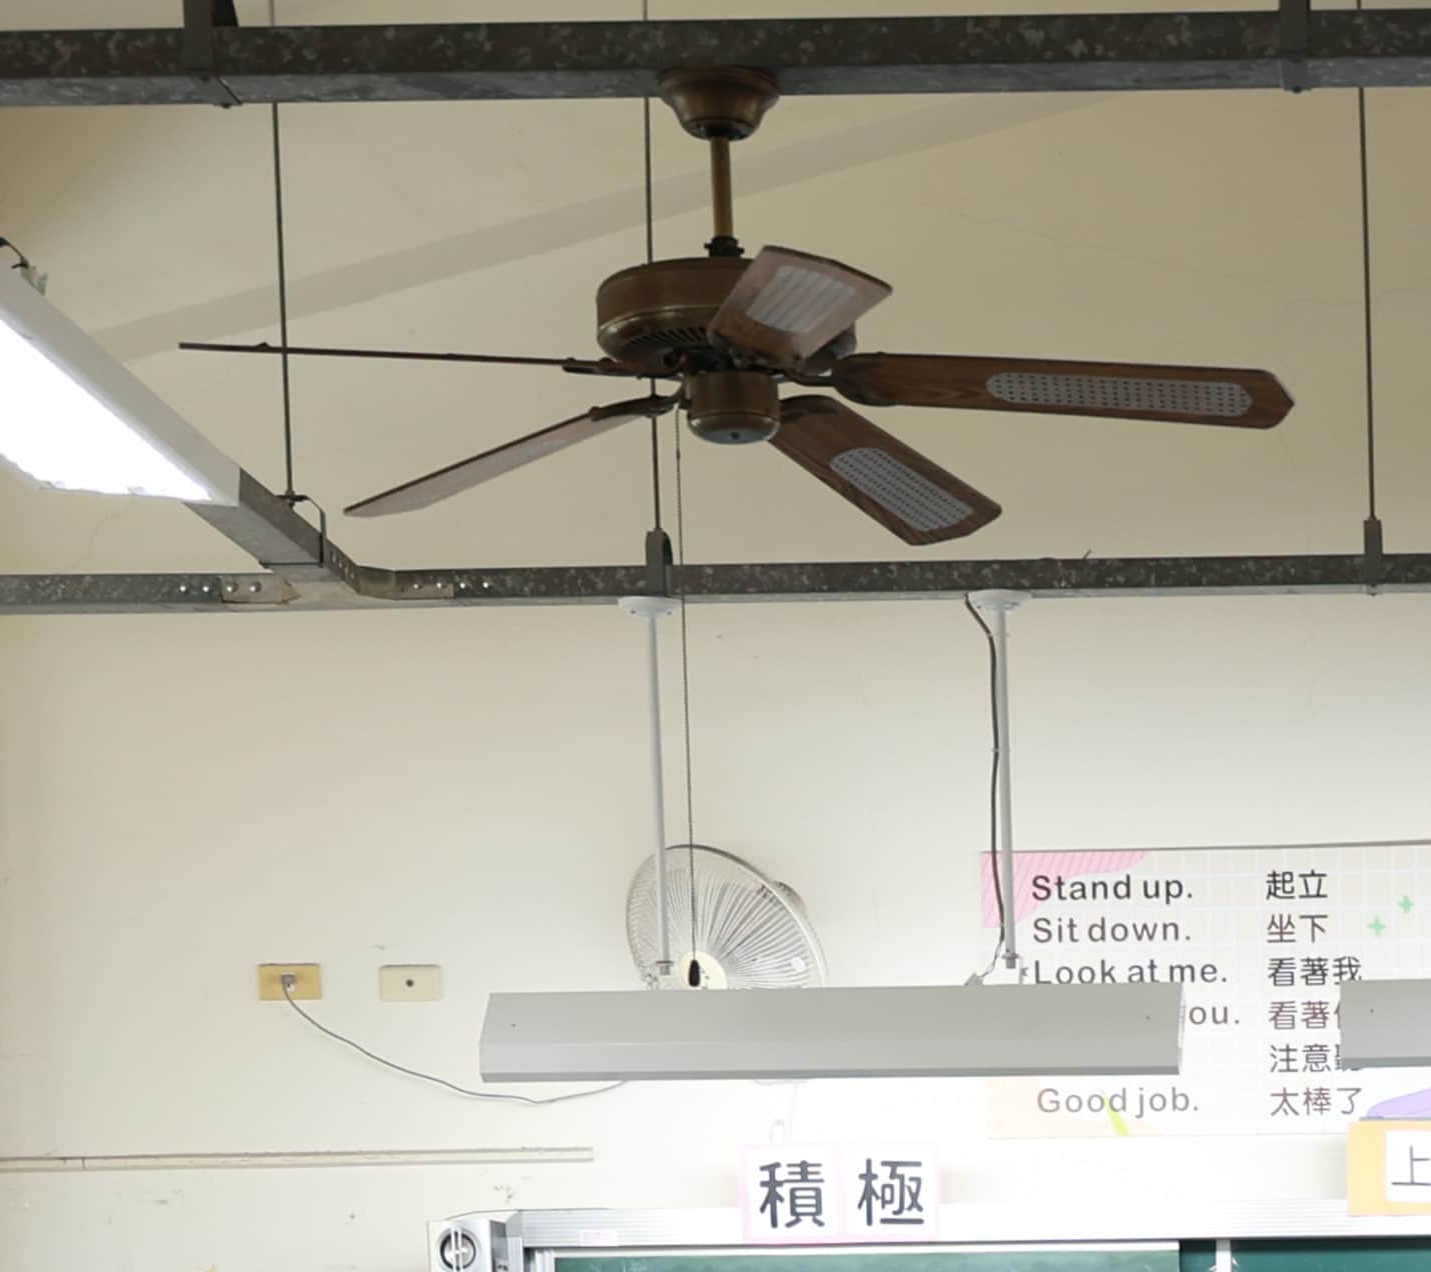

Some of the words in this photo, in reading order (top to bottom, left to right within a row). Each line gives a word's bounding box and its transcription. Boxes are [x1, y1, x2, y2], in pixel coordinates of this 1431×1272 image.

[1031, 873, 1132, 902] Stand
[1143, 877, 1194, 906] up.
[1265, 869, 1329, 901] 起立
[1032, 917, 1080, 943] Sit
[1090, 917, 1191, 943] down.
[1266, 913, 1329, 944] 坐下
[1034, 959, 1115, 985] Look
[1127, 961, 1161, 984] at
[1169, 966, 1228, 984] me.
[1267, 955, 1362, 987] 看著我
[1188, 1003, 1241, 1026] ou.
[1268, 1000, 1341, 1032] 看著
[1036, 1086, 1129, 1115] Good
[1136, 1086, 1200, 1119] job.
[1270, 1085, 1362, 1118] 太棒了
[759, 1157, 925, 1230] 積極
